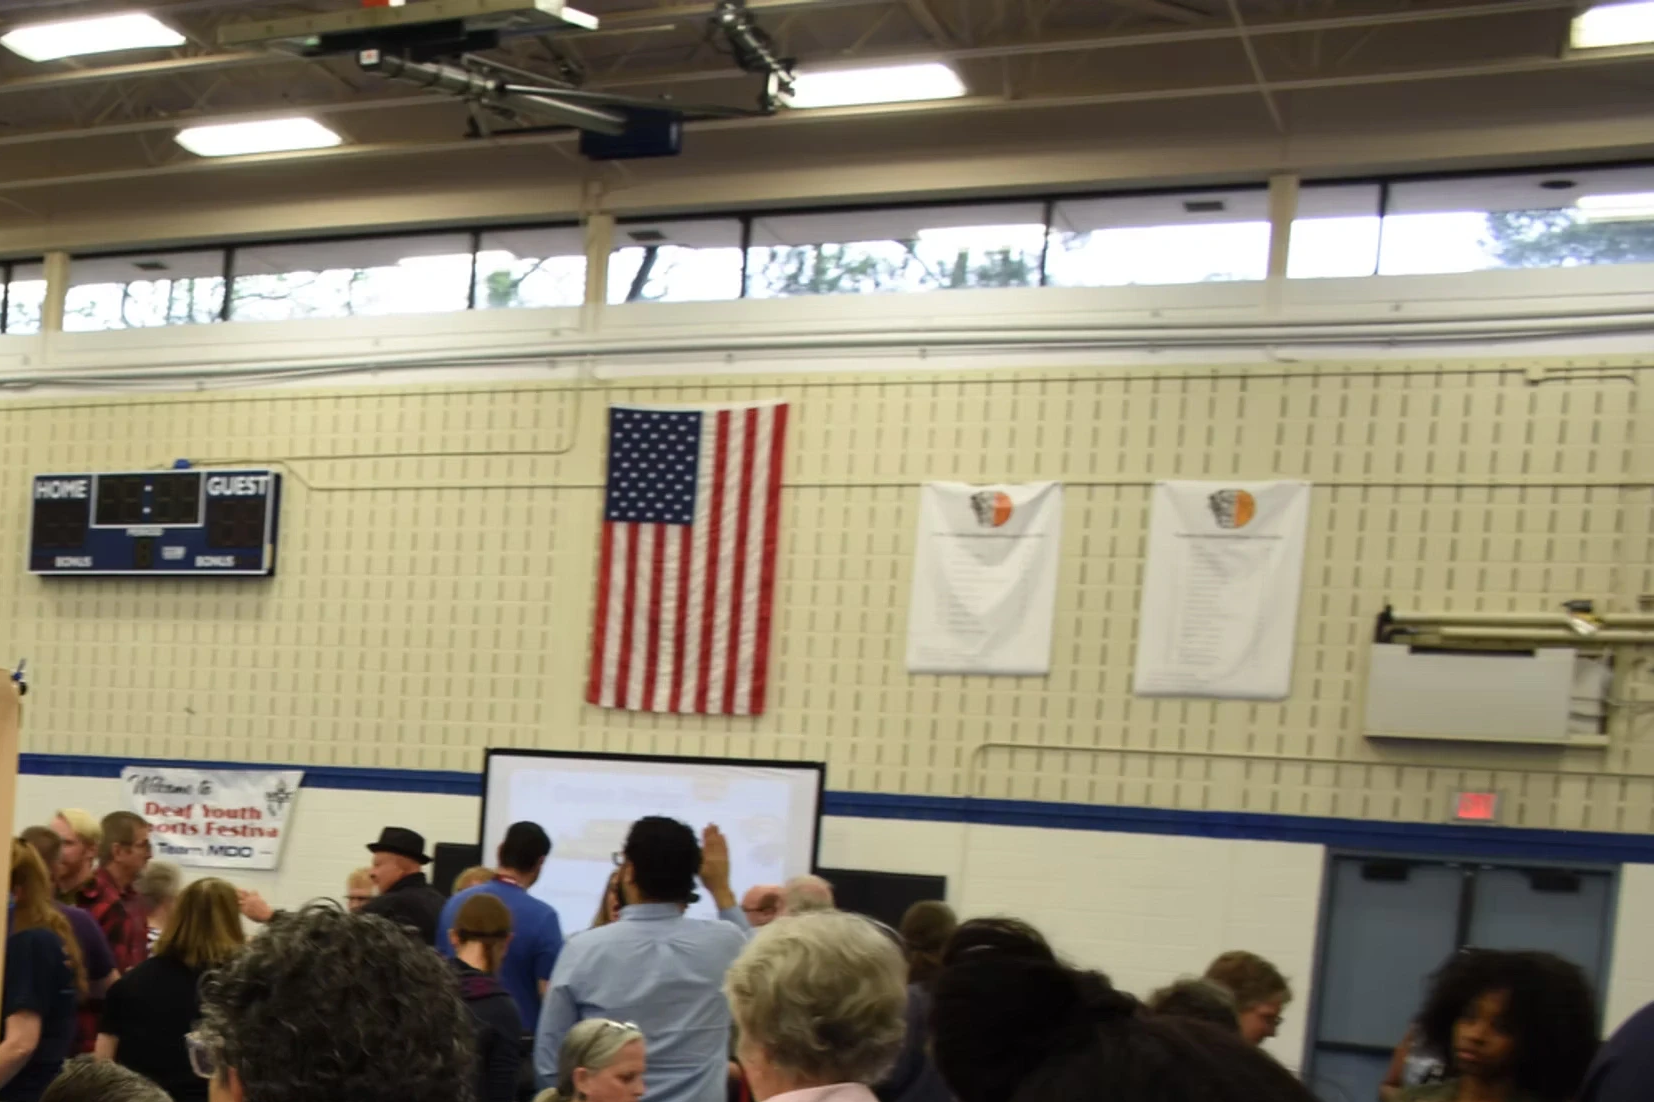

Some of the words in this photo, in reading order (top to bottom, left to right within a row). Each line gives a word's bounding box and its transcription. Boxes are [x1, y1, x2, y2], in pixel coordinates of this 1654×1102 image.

[34, 480, 88, 499] HOME
[206, 476, 270, 496] GUEST
[145, 802, 192, 819] Deaf
[203, 804, 262, 821] Youth
[150, 822, 198, 835] orts
[205, 822, 279, 838] Festiva
